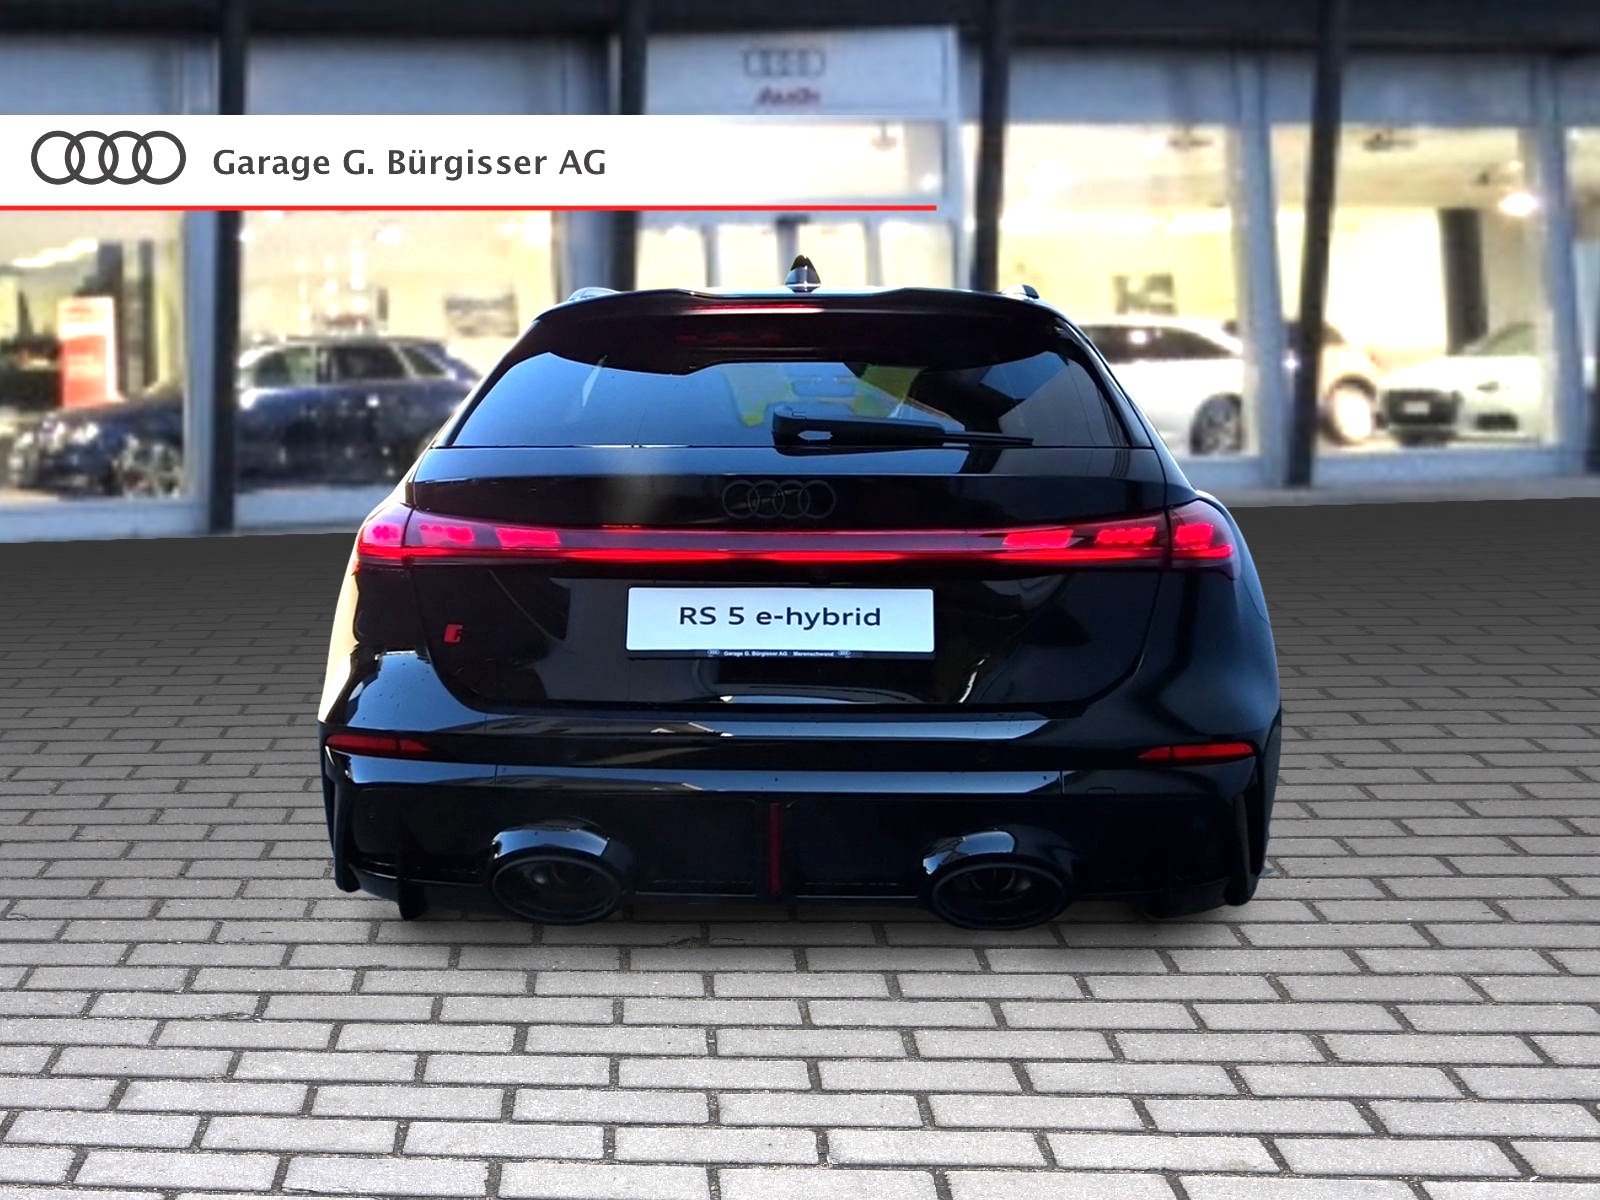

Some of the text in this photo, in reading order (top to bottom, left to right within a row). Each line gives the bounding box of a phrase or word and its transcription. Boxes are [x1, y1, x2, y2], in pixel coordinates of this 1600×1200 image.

[679, 606, 881, 631] RS 5 e-hybrid
[723, 650, 744, 658] Garage
